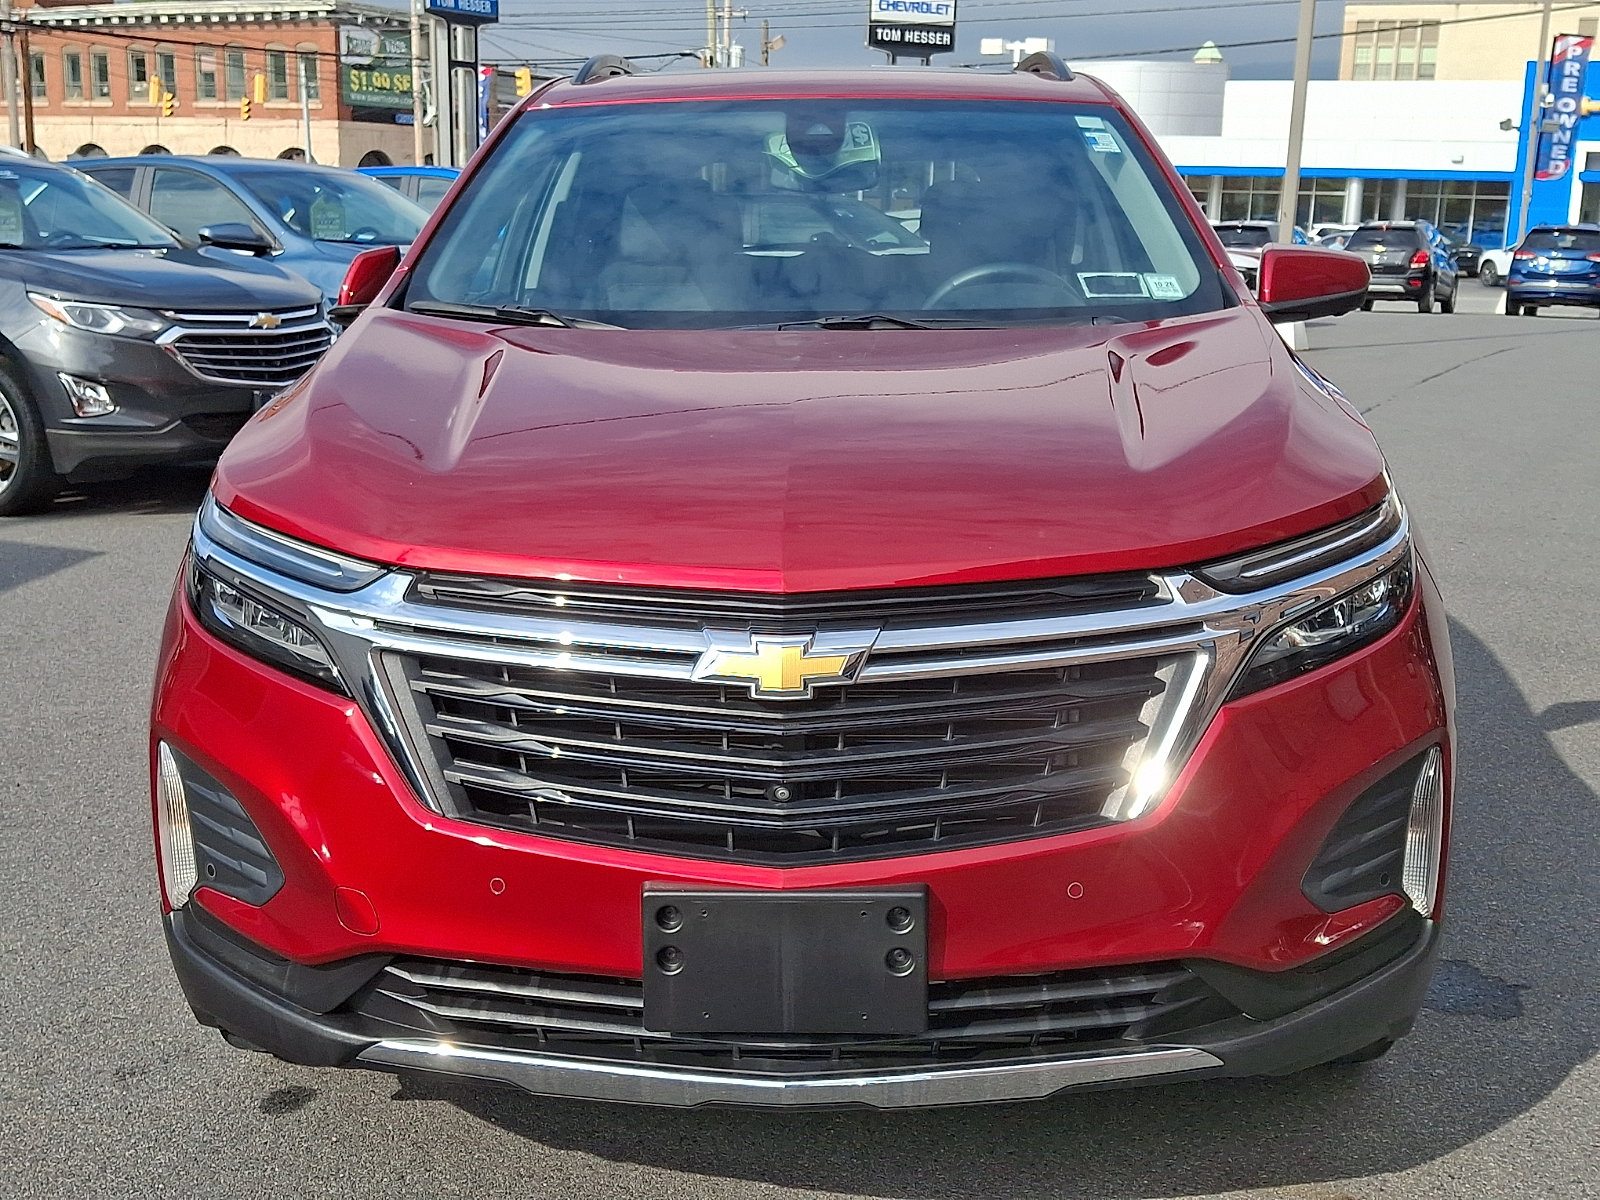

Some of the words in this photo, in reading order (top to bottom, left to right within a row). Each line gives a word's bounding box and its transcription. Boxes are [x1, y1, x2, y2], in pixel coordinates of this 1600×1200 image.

[459, 0, 491, 13] HESSER
[879, 0, 951, 15] CHEVROLET
[876, 28, 901, 42] TOM
[904, 30, 951, 46] HESSER
[1561, 45, 1583, 93] PRE
[350, 69, 391, 92] $1.99
[1548, 97, 1577, 175] OWNED
